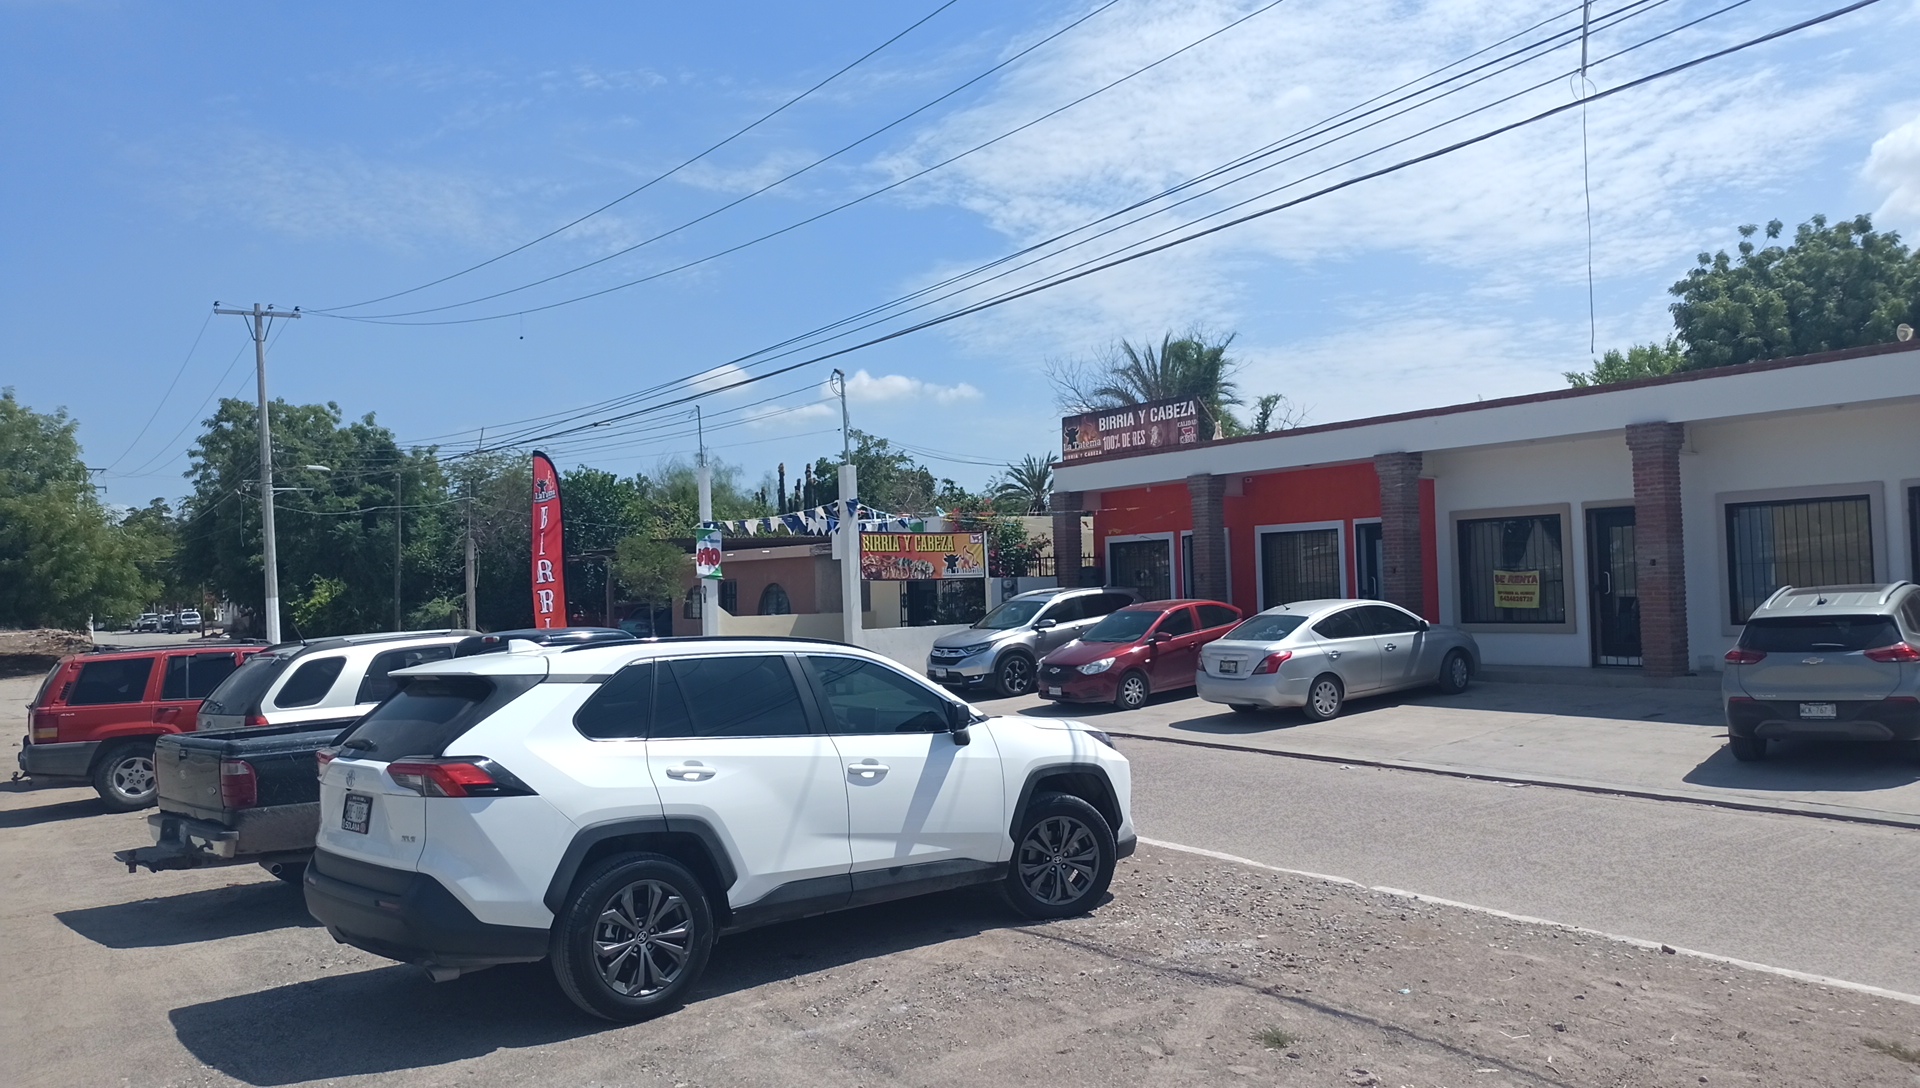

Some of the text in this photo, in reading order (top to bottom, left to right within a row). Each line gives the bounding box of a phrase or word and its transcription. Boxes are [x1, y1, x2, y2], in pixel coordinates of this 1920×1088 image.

[1098, 400, 1196, 432] BIRRIA Y CABEZA
[1103, 430, 1146, 450] 100% DE RES
[862, 534, 955, 552] BIRRIA Y CABEZA
[697, 547, 720, 566] $10
[1495, 575, 1538, 584] SE RENTA
[345, 822, 360, 832] SOLANA
